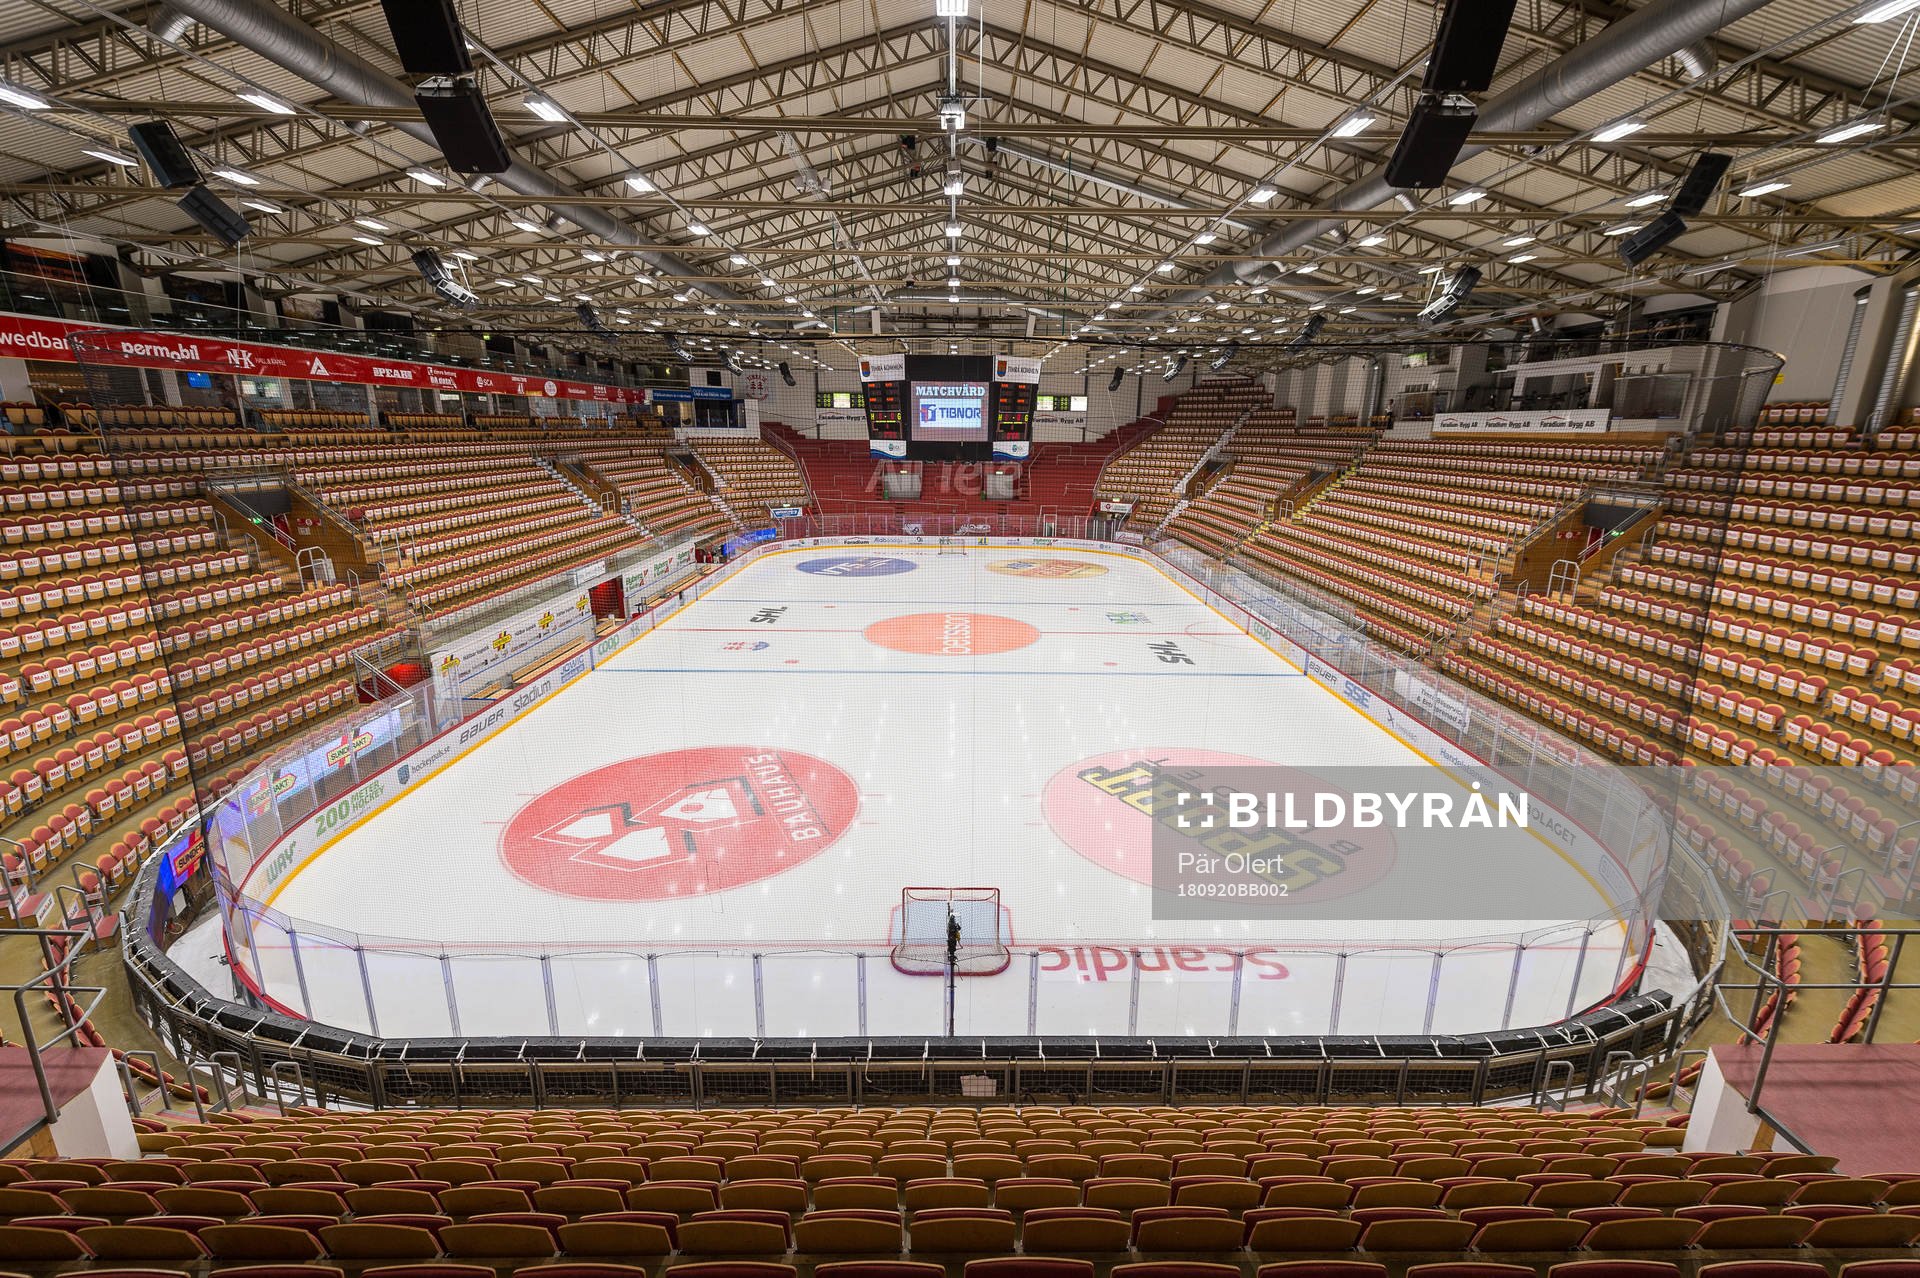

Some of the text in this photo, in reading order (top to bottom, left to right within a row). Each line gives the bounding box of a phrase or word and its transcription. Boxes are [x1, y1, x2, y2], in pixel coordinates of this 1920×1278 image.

[121, 341, 200, 362] permobil
[915, 383, 986, 397] MATCHVÄRD
[938, 407, 981, 419] TIBNOR
[750, 606, 788, 624] SHL
[1147, 640, 1196, 666] SHL
[749, 753, 820, 842] BAUHAUS
[315, 800, 351, 837] 200
[1039, 946, 1290, 983] Scandic
